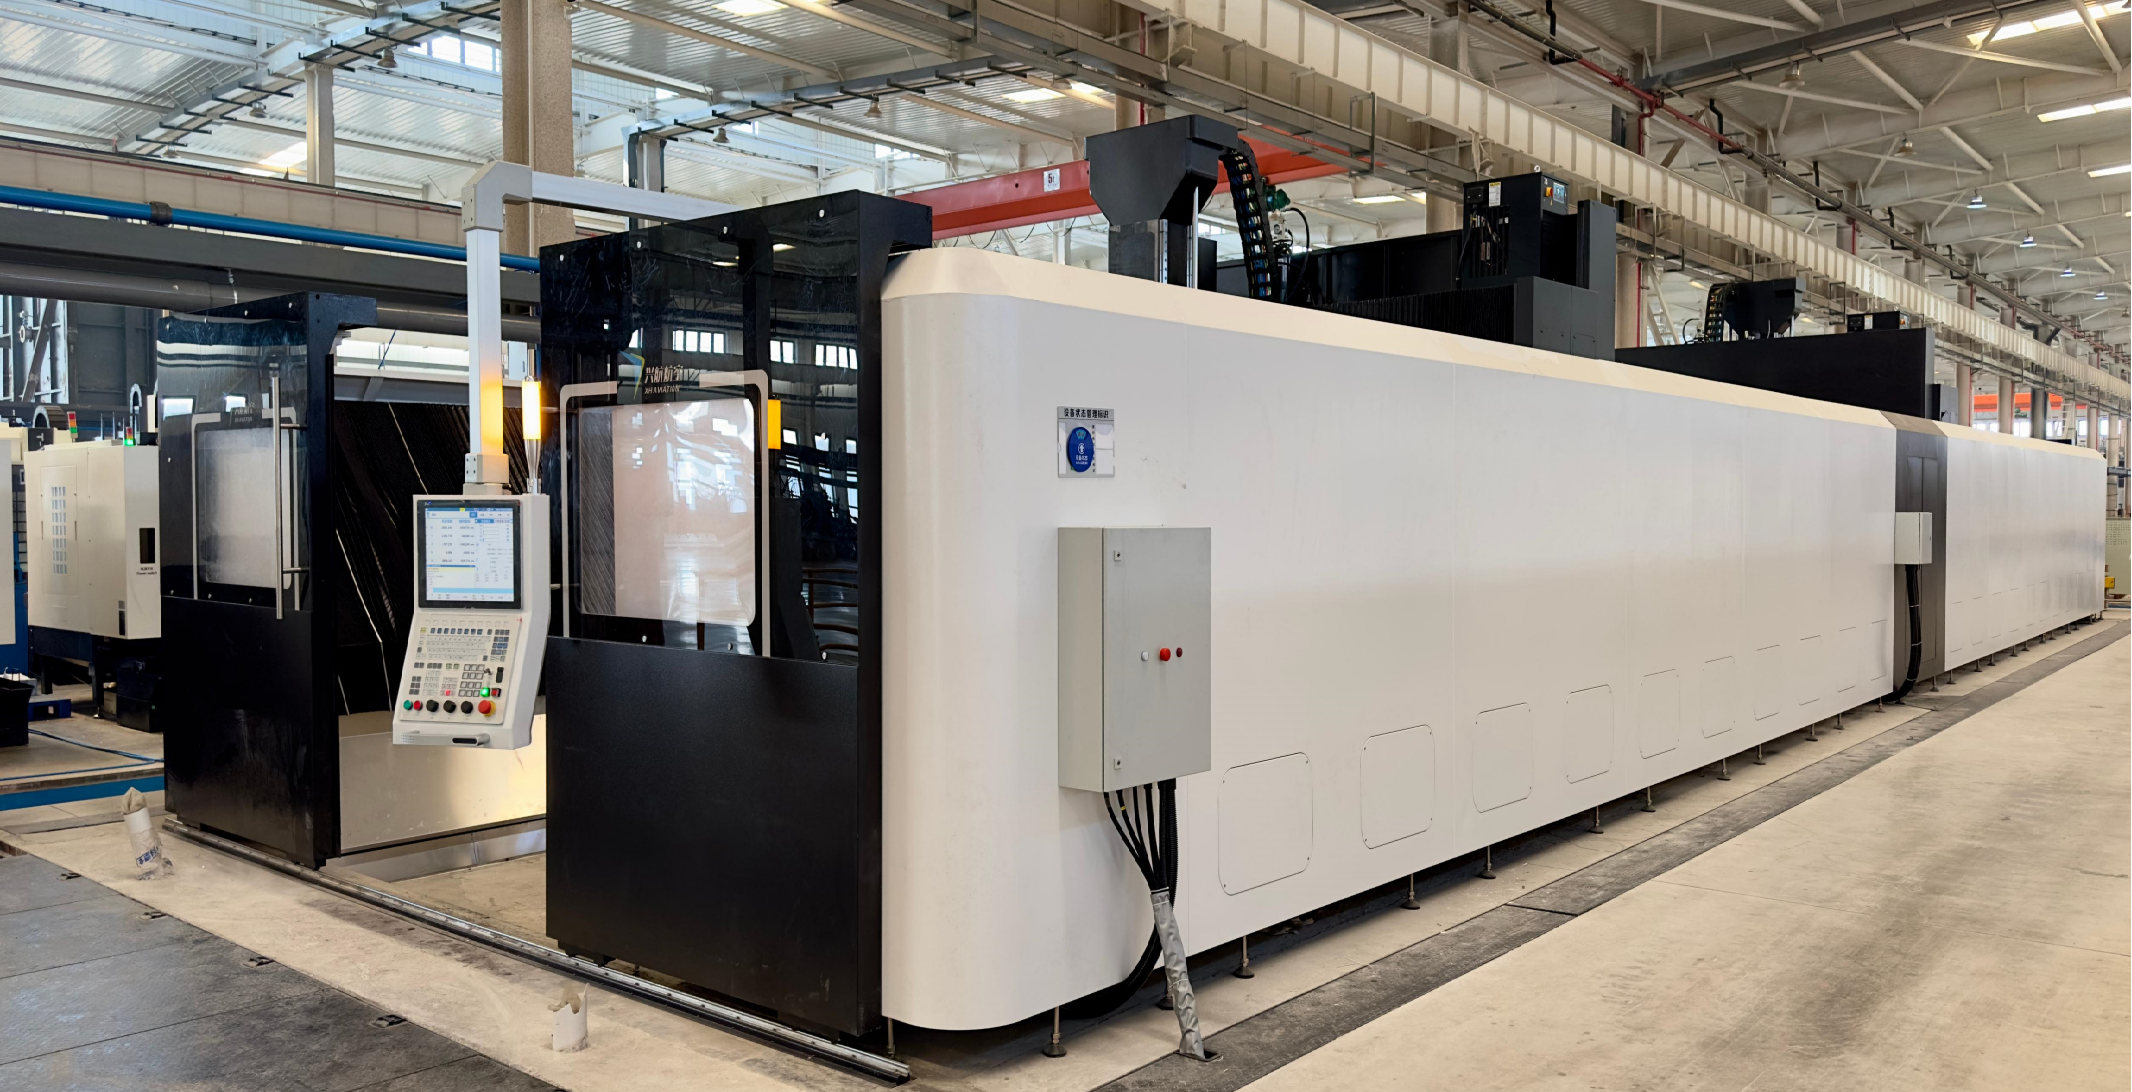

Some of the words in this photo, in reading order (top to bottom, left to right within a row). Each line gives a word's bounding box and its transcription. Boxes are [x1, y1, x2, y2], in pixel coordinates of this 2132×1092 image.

[1064, 408, 1109, 419] 设备状态管理标识
